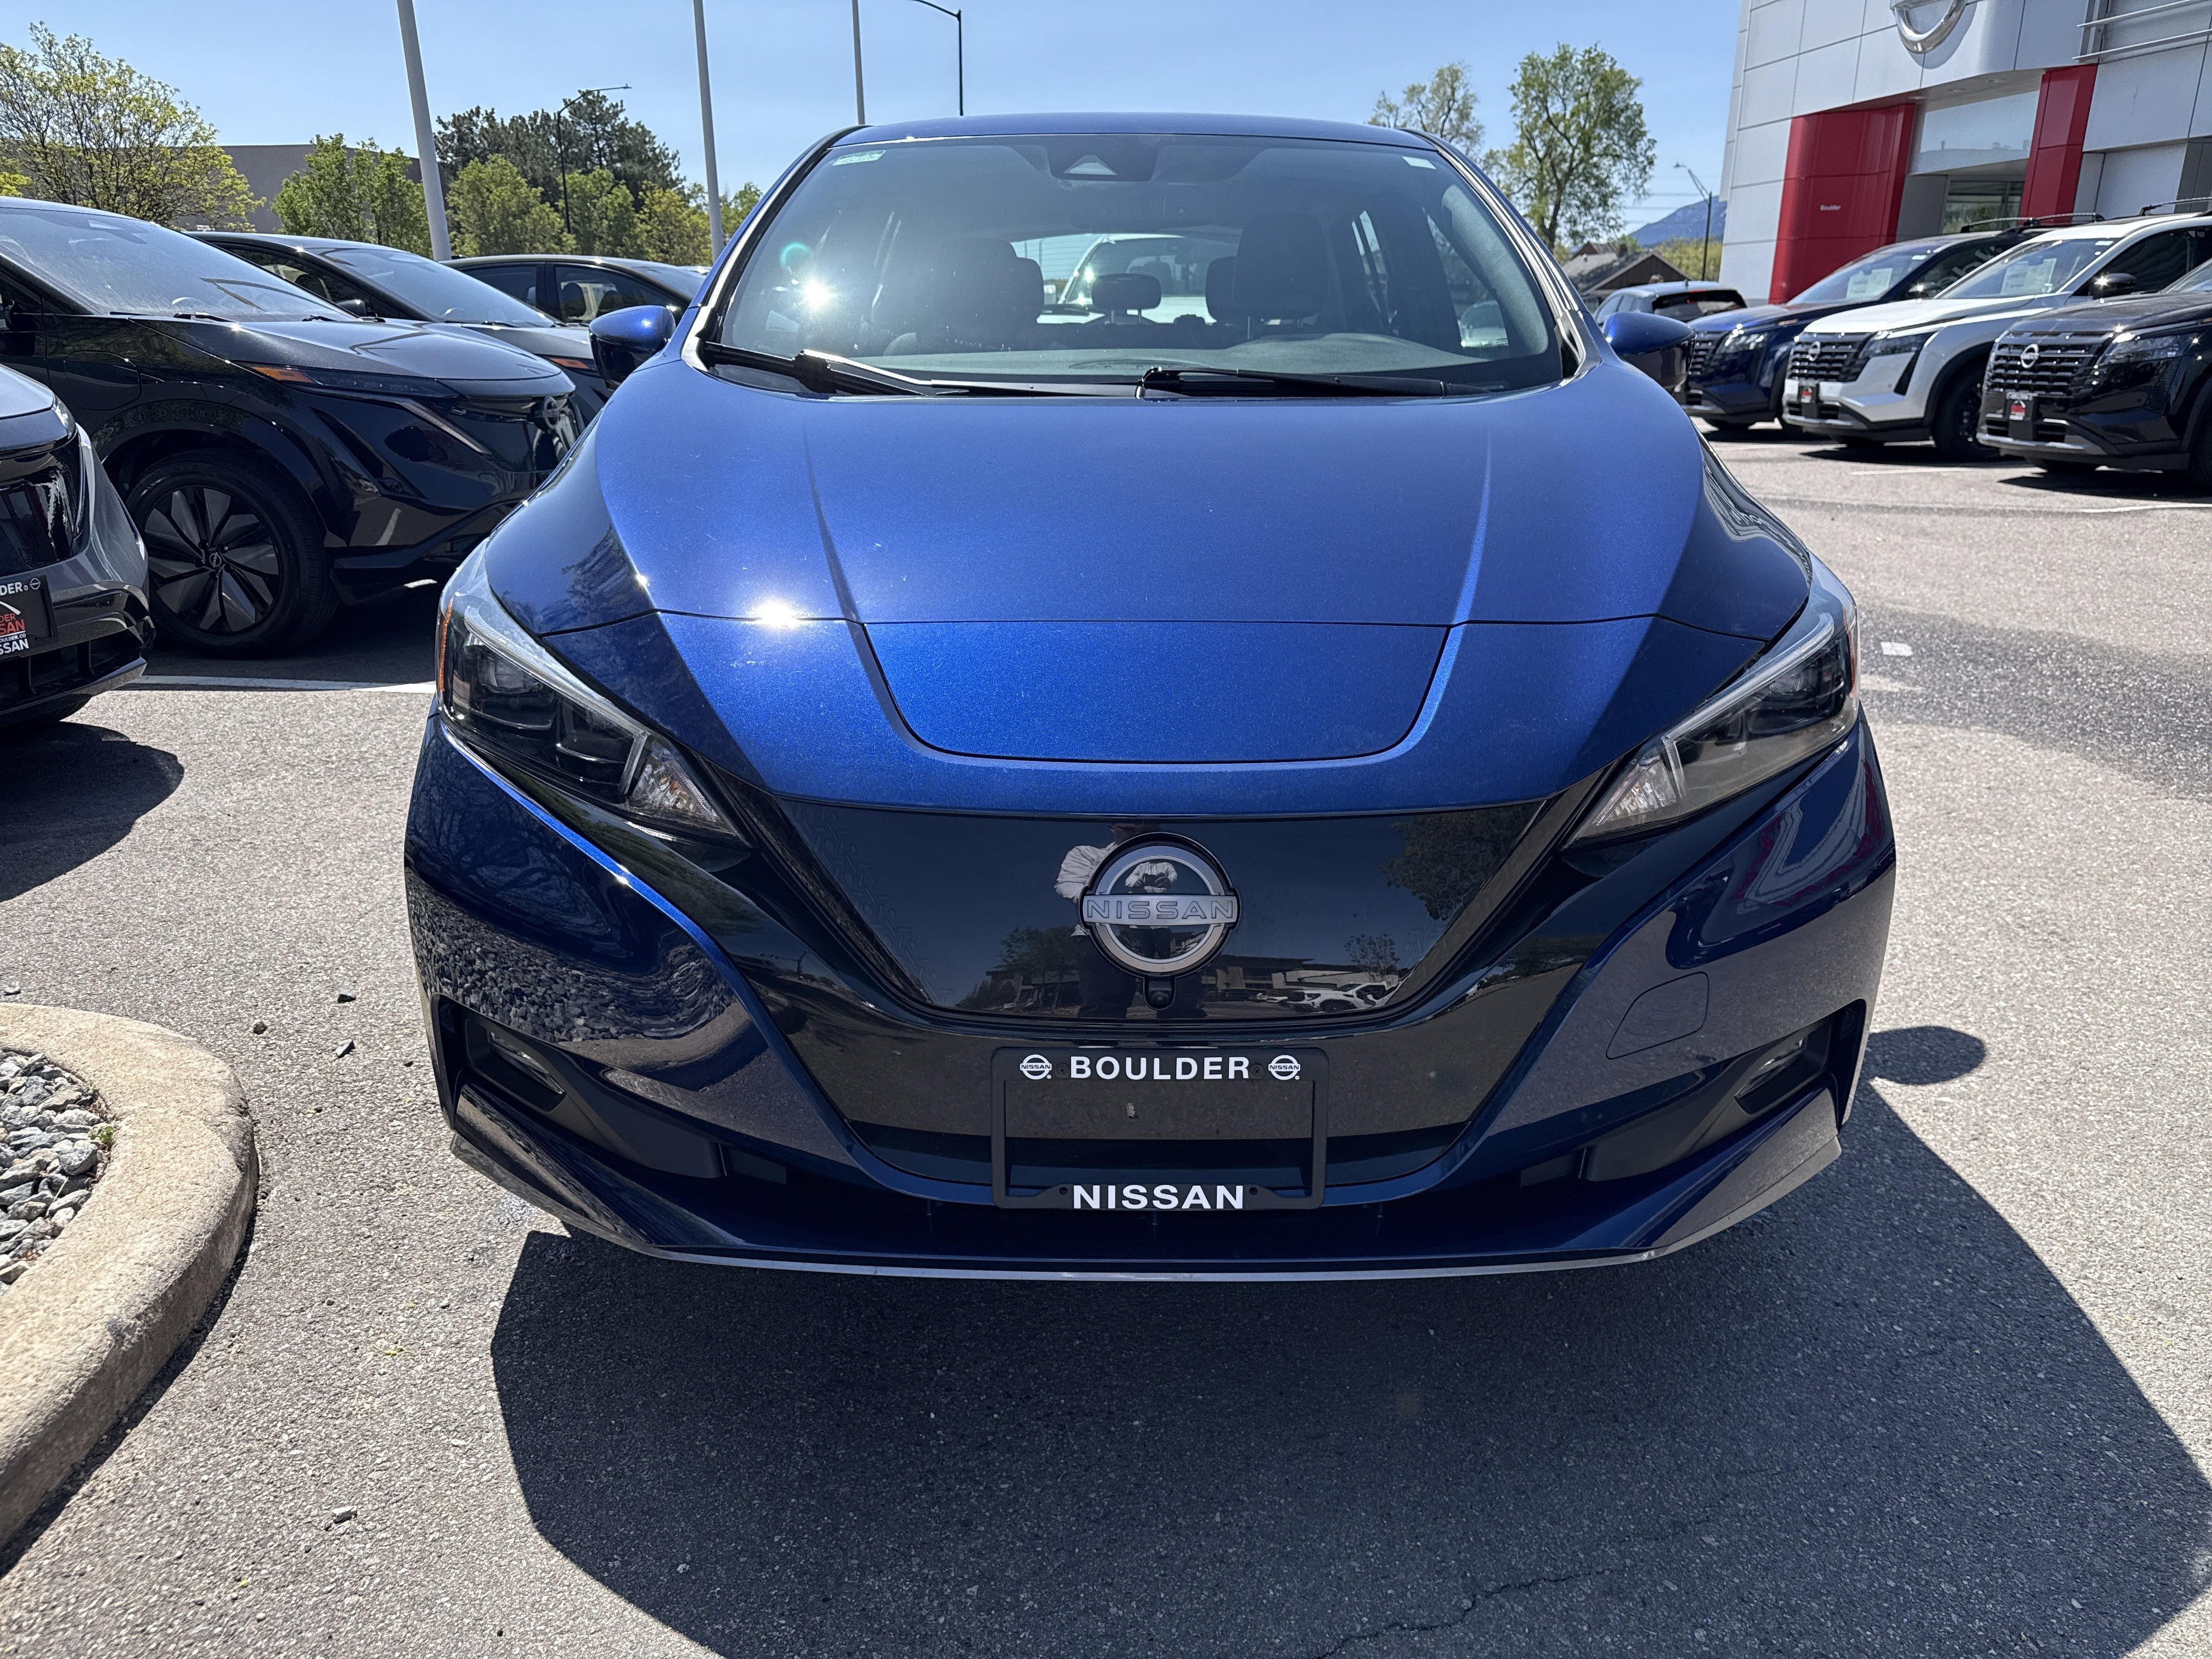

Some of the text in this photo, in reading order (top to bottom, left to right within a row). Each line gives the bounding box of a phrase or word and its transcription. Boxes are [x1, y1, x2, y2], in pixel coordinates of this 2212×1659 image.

[1087, 900, 1233, 919] NISSAN
[1070, 1056, 1250, 1080] BOULDER
[1074, 1185, 1243, 1209] NISSAN
